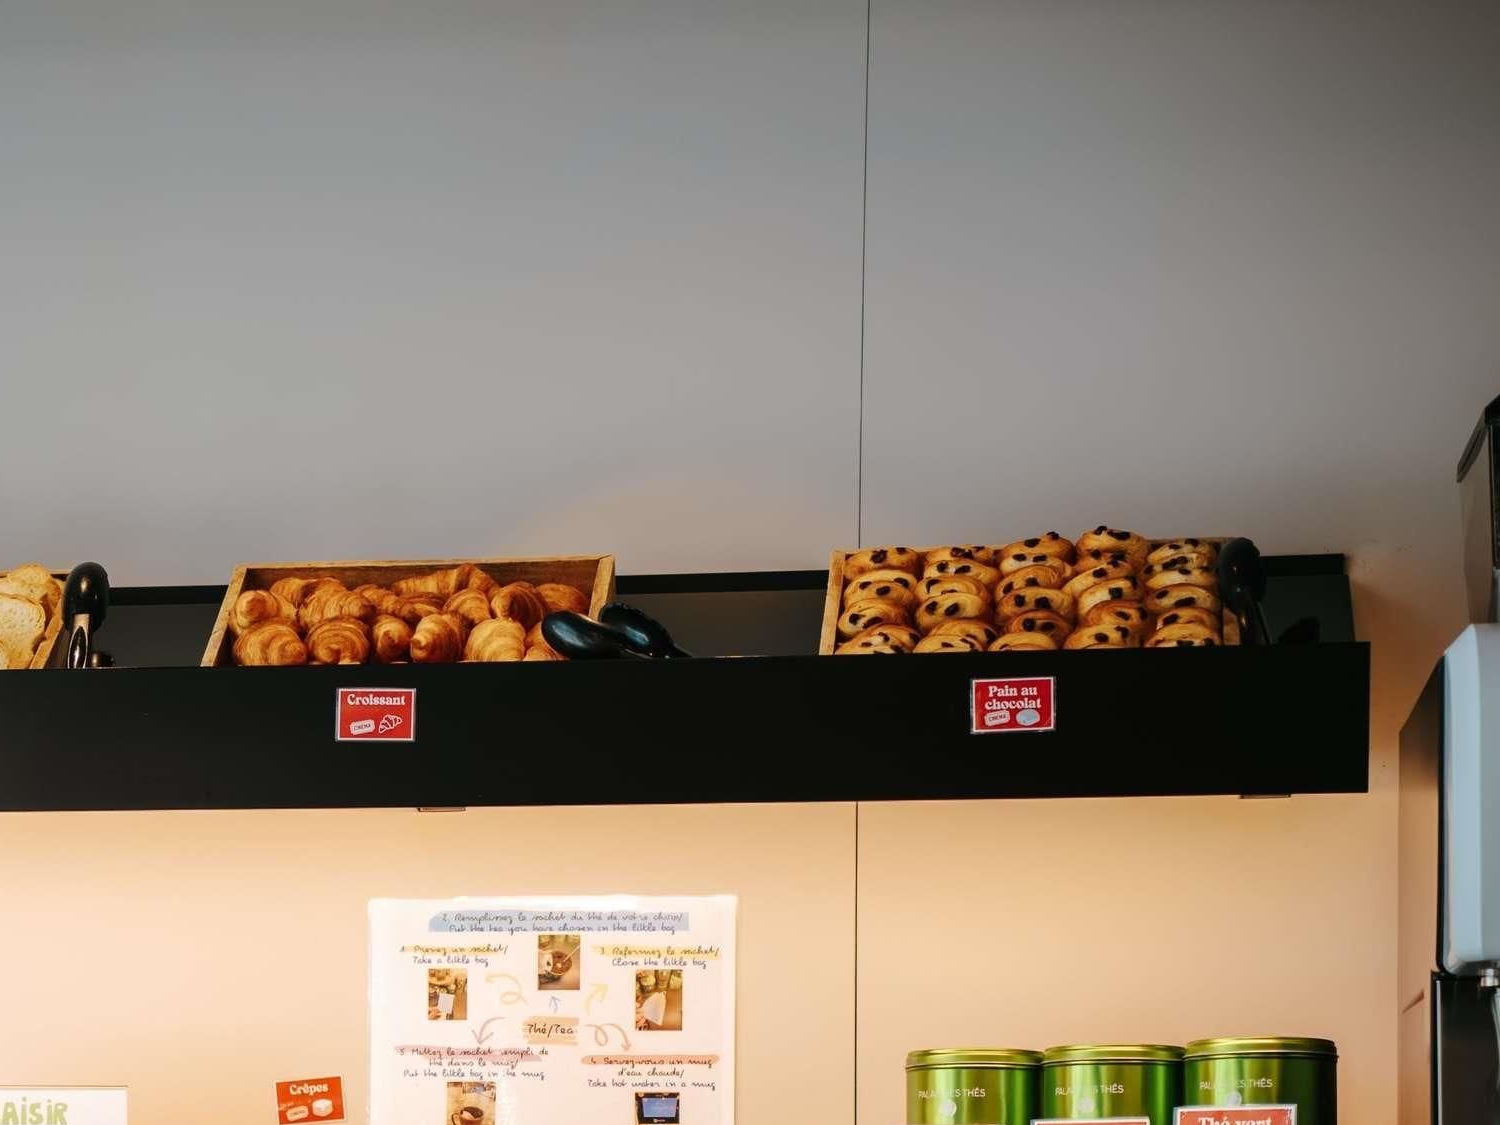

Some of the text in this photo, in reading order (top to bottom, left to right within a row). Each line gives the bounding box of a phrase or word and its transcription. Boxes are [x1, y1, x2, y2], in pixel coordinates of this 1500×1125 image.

[988, 684, 1037, 698] Pain au
[347, 693, 406, 706] Croissant
[984, 697, 1042, 711] chocolat
[412, 955, 432, 964] Take
[612, 957, 639, 966] Close
[644, 957, 658, 966] the
[692, 957, 707, 970] bag
[588, 1078, 607, 1087] Take
